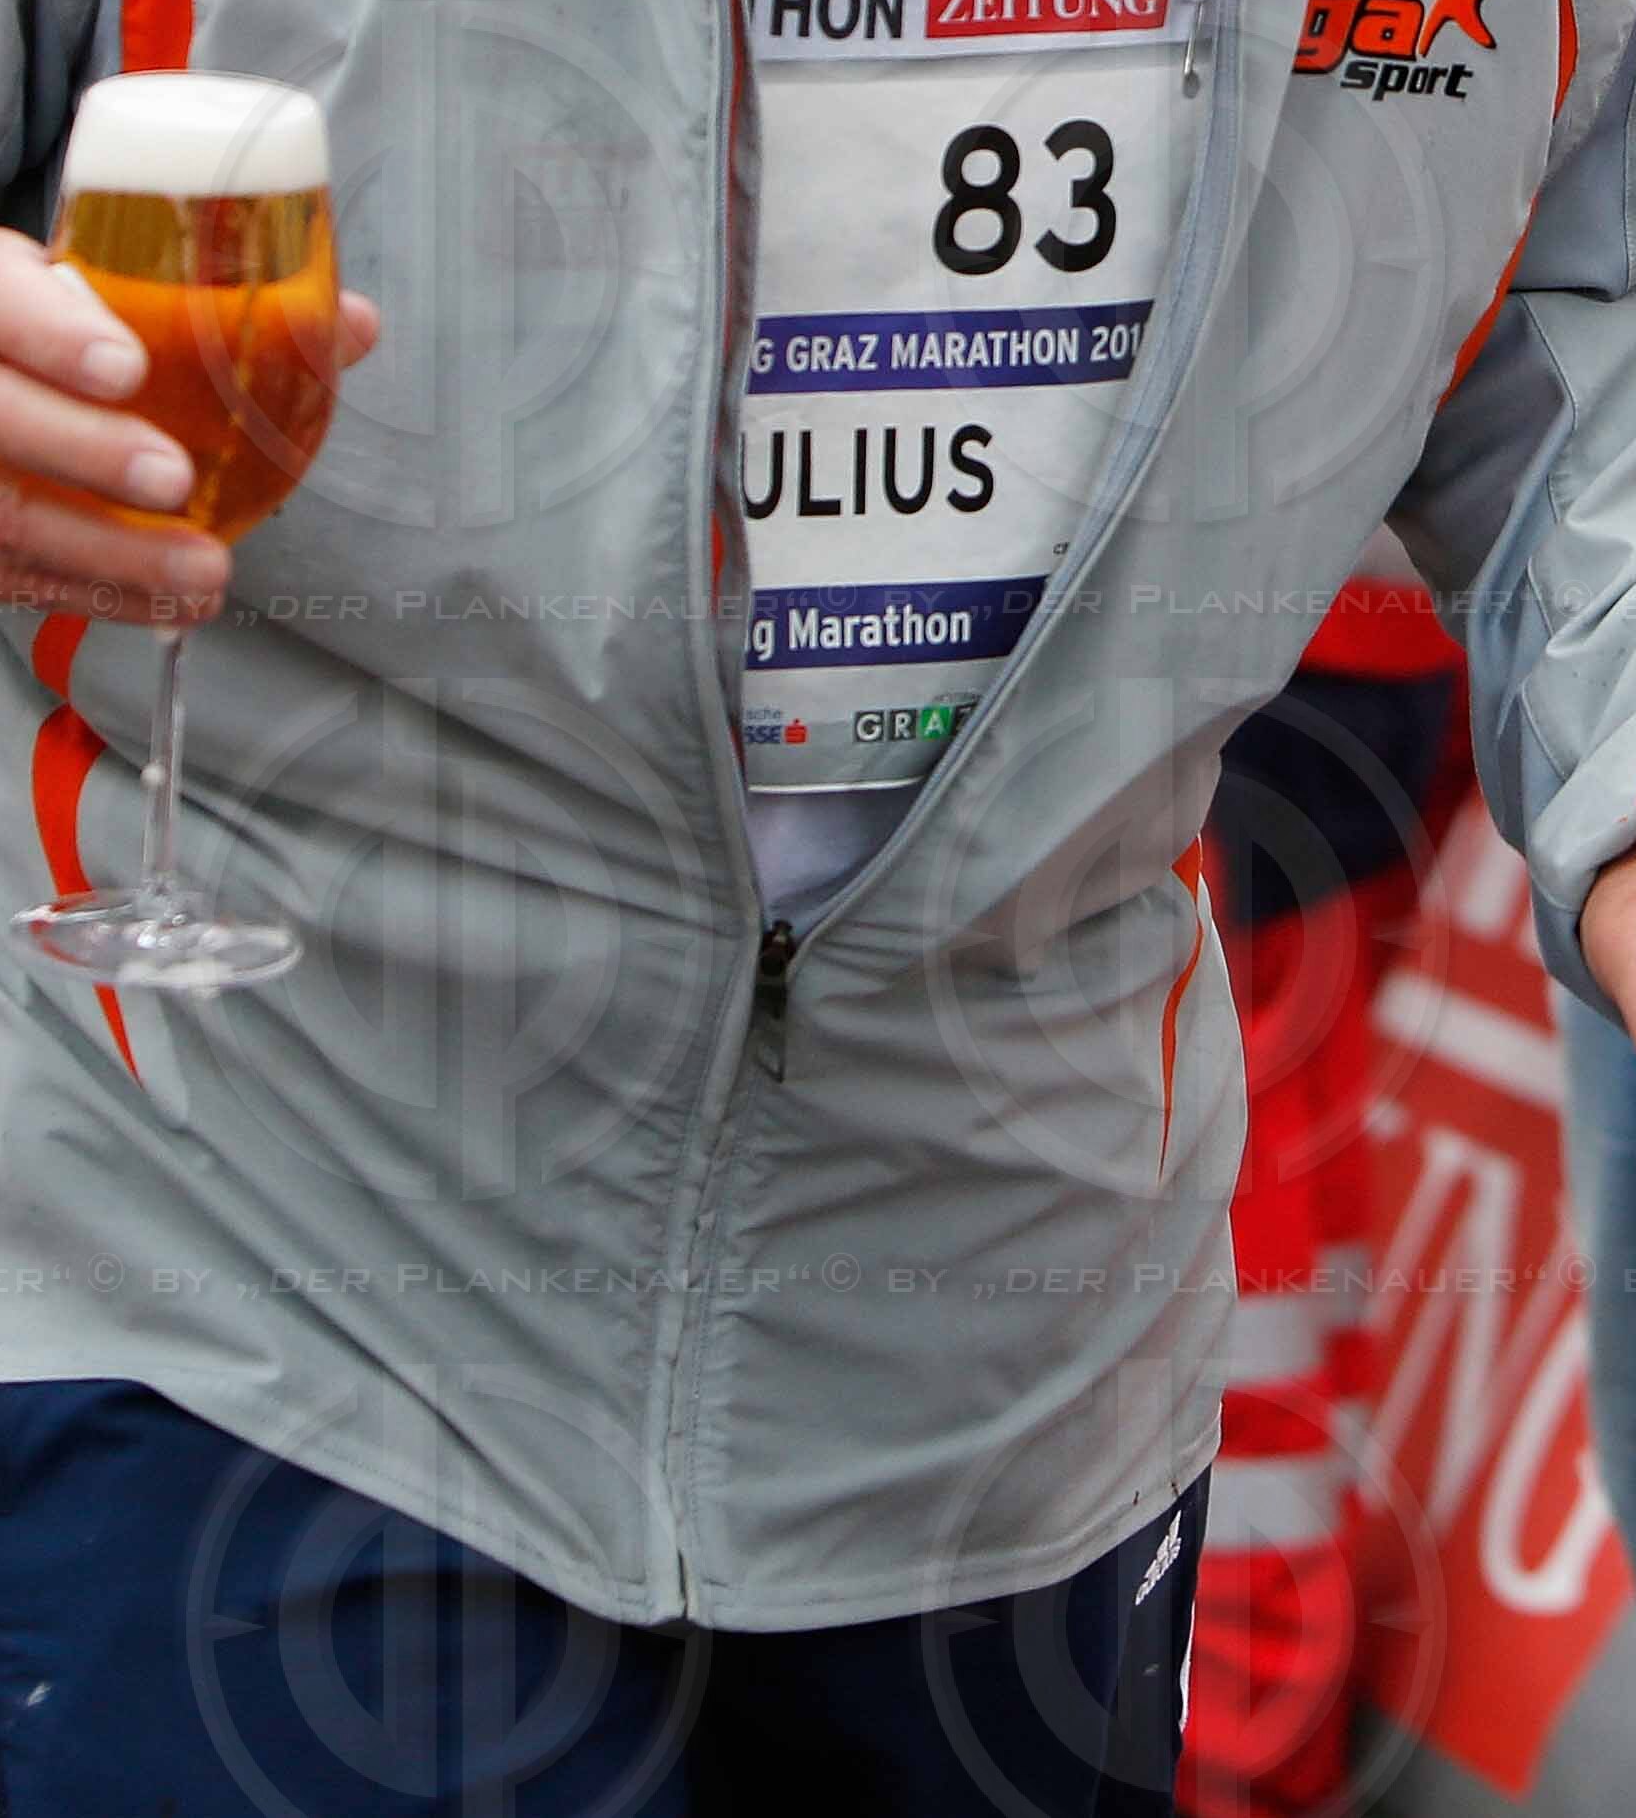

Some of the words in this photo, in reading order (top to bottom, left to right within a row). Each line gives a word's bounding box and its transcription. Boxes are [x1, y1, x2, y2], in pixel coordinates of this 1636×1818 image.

[1340, 59, 1474, 101] sport
[932, 118, 1118, 277] 83
[785, 333, 879, 373] GRAZ
[890, 327, 1080, 369] MARATHON
[740, 423, 995, 520] ULIUS
[747, 618, 776, 662] g
[787, 602, 973, 651] Marathon
